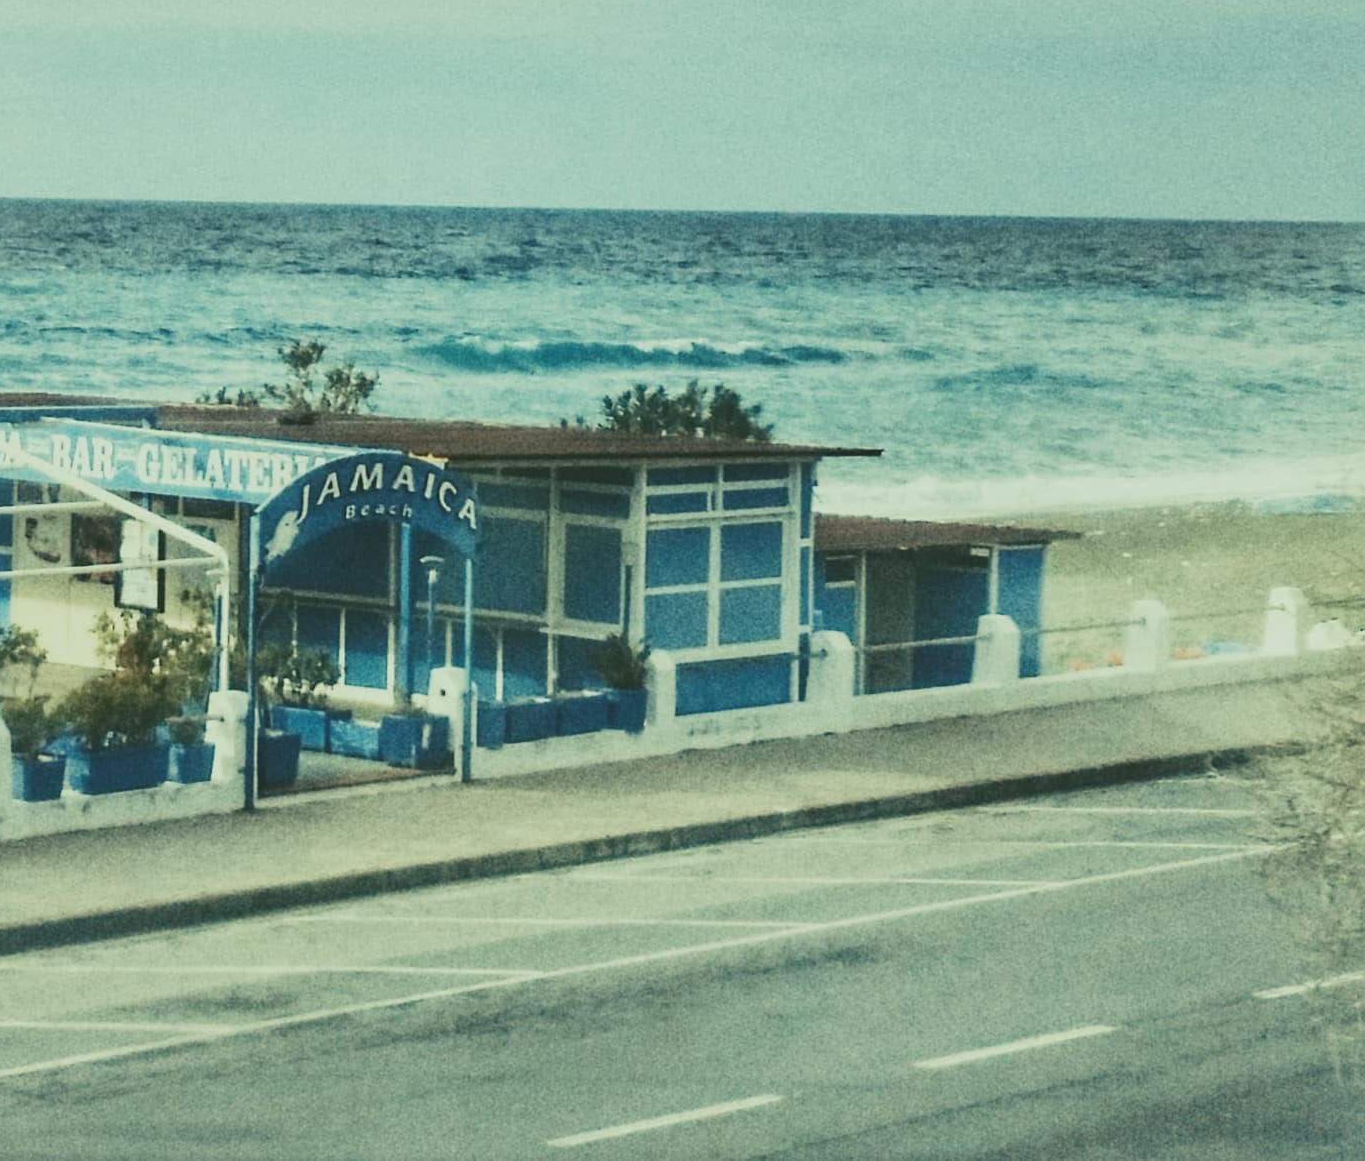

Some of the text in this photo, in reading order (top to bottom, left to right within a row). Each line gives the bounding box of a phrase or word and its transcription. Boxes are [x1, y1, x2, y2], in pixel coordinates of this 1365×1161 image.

[50, 433, 116, 480] BAR
[137, 441, 327, 495] GELATERI
[296, 462, 478, 530] JAMAICA
[344, 502, 414, 520] Beach
